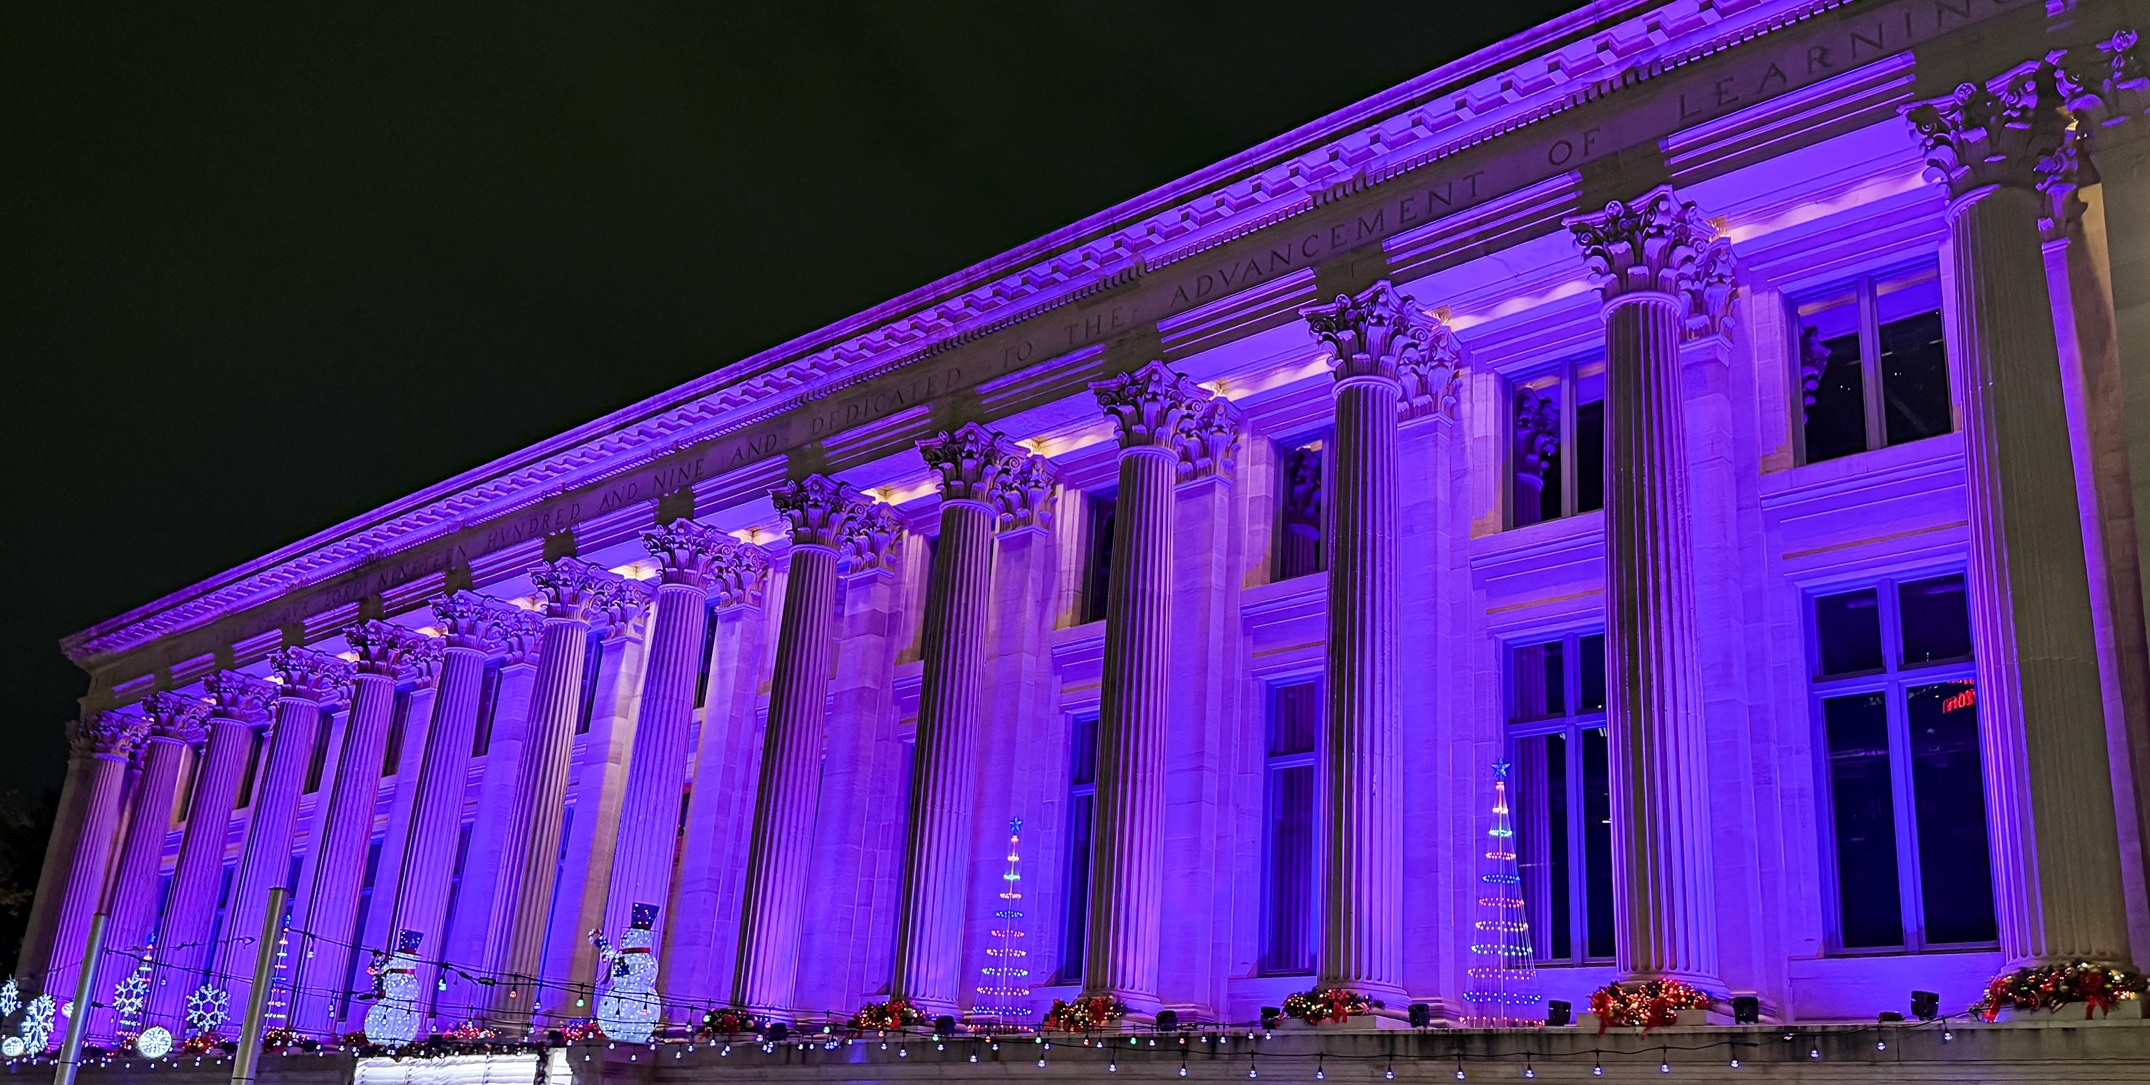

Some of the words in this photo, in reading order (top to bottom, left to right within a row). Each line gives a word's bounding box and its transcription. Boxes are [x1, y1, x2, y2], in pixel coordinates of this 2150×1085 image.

[599, 482, 638, 511] AND
[653, 458, 705, 492] NINE
[729, 434, 777, 466] AND
[811, 367, 962, 436] DEDICATED
[1002, 341, 1033, 368] TO
[1063, 306, 1126, 345] THE
[1170, 171, 1486, 307] ADVANCEMENT
[1548, 126, 1602, 167] OF
[1677, 0, 2010, 122] LEARNIN
